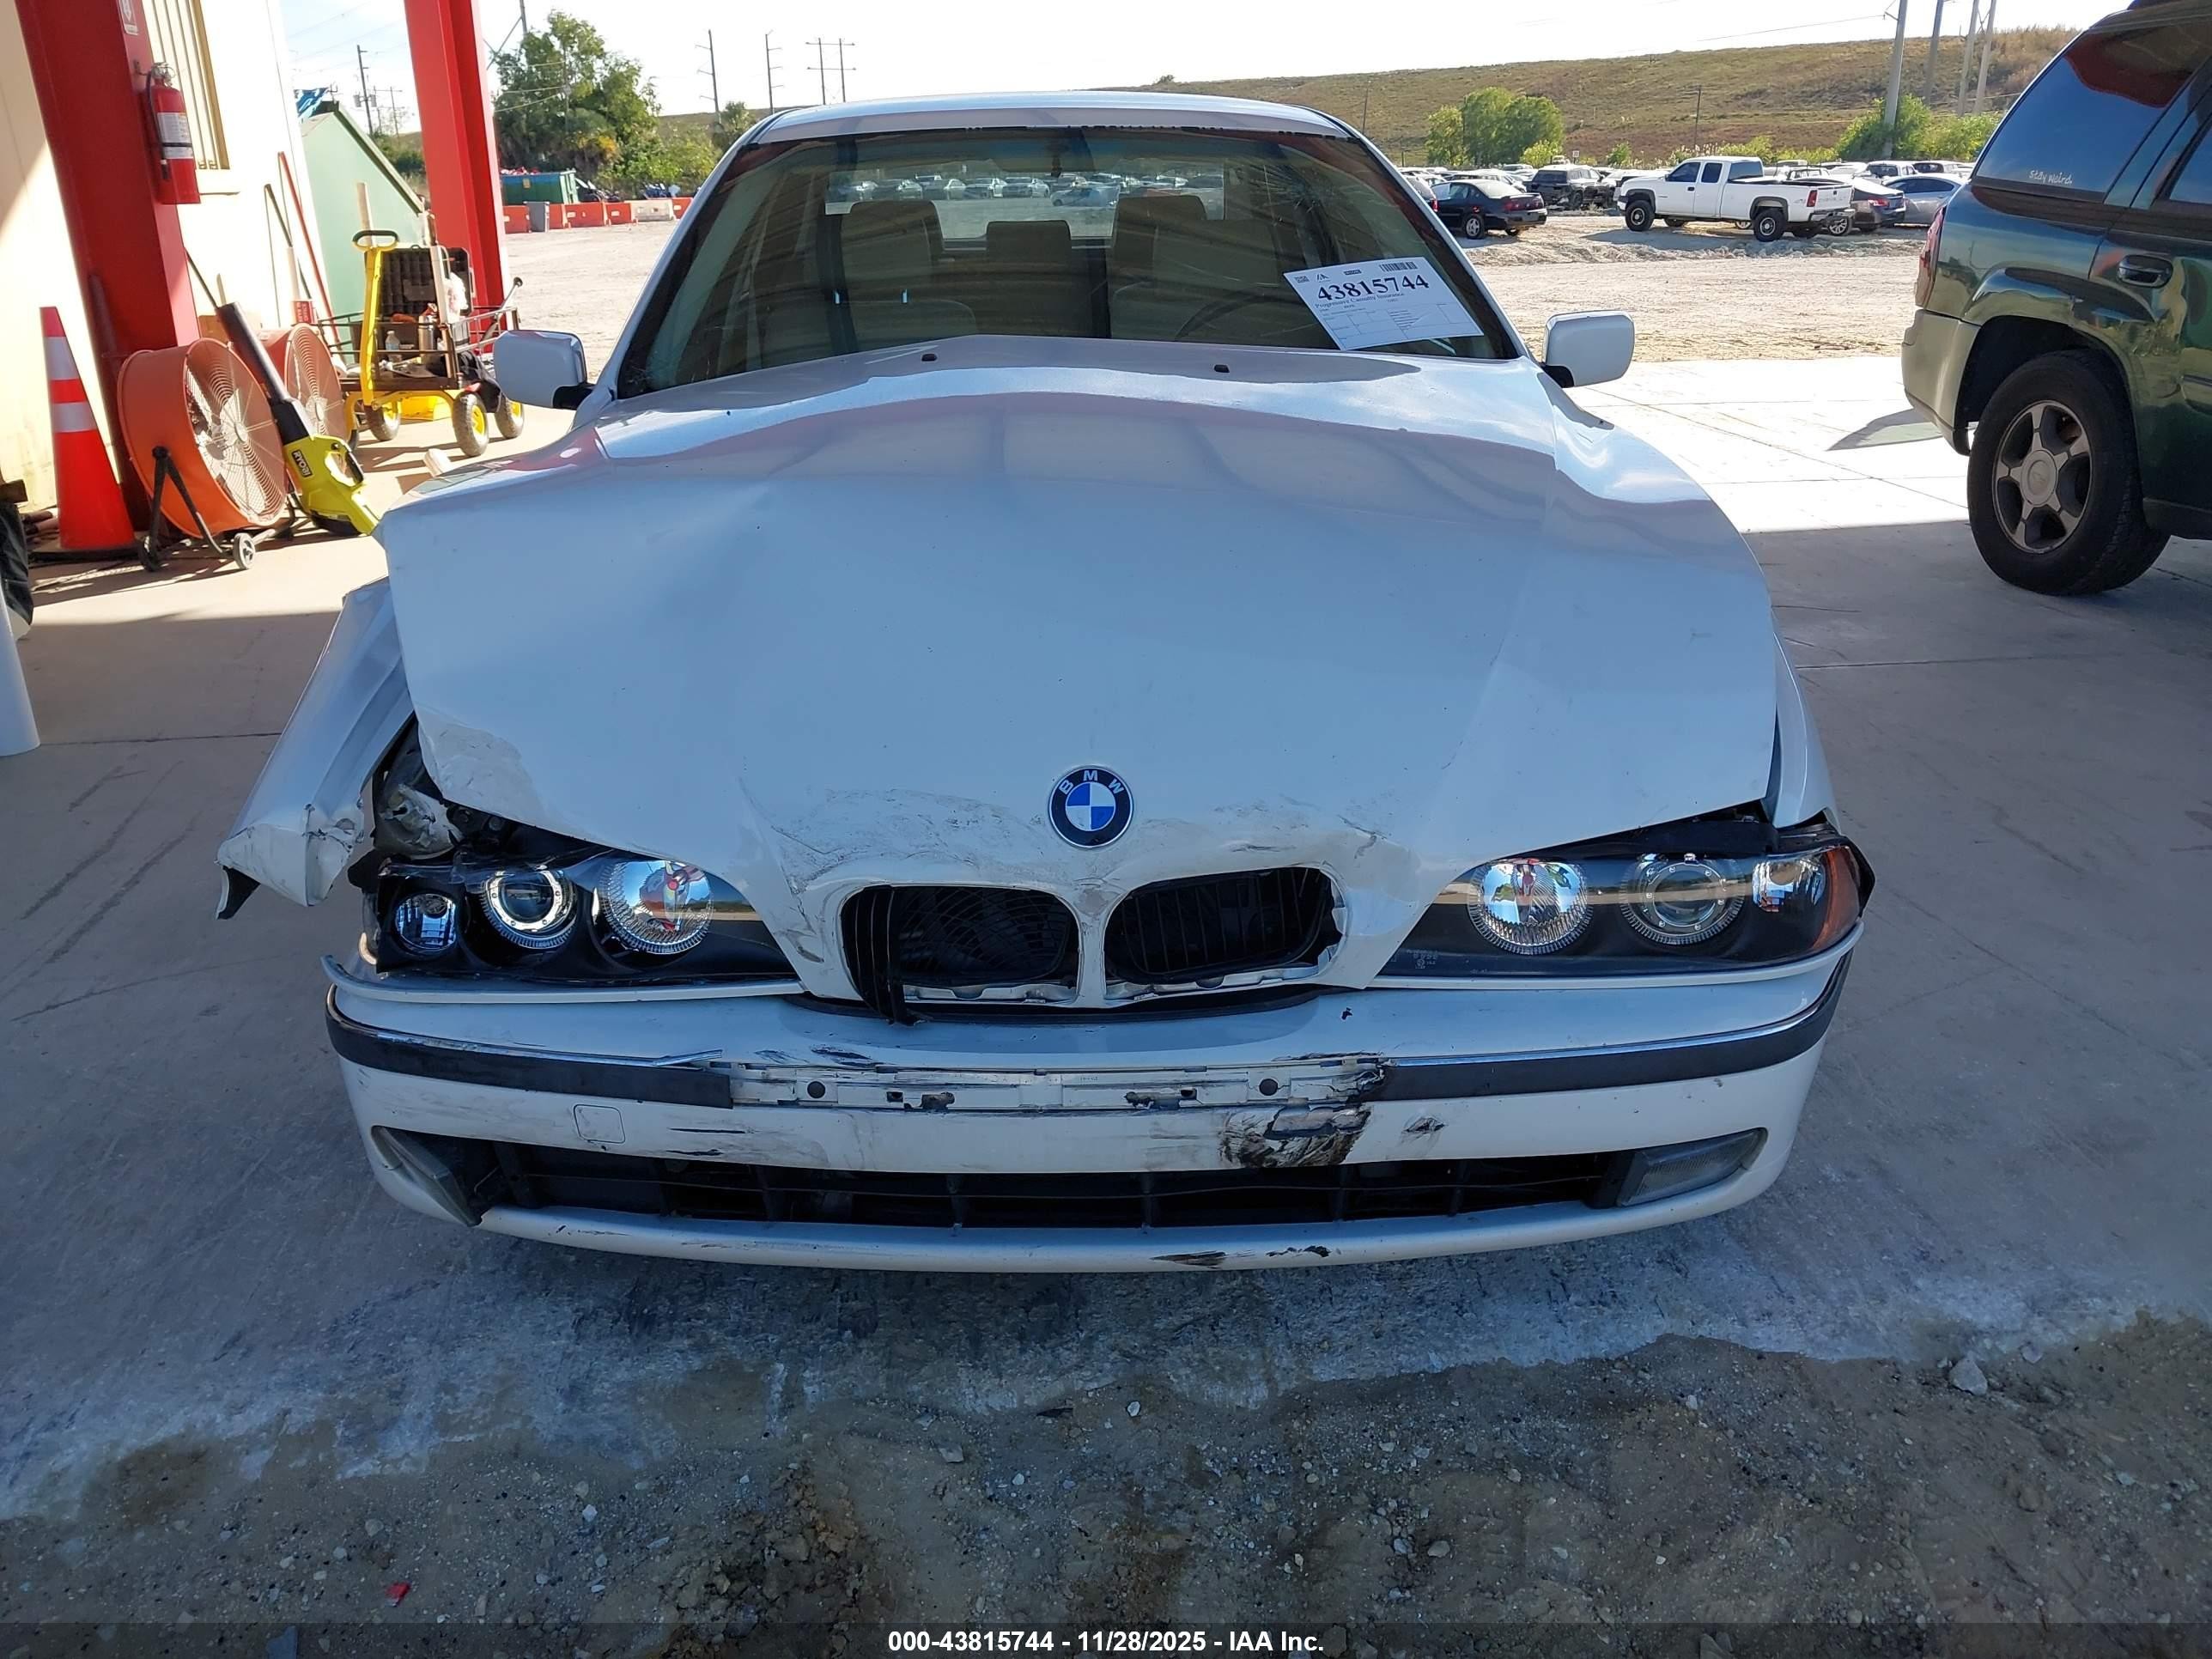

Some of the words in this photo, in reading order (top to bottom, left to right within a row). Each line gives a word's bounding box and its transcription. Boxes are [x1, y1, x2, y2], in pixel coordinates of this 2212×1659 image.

[2029, 170, 2047, 183] Stay
[1317, 274, 1430, 301] 43815744
[293, 451, 311, 476] RYOBI
[1058, 769, 1125, 795] BMW
